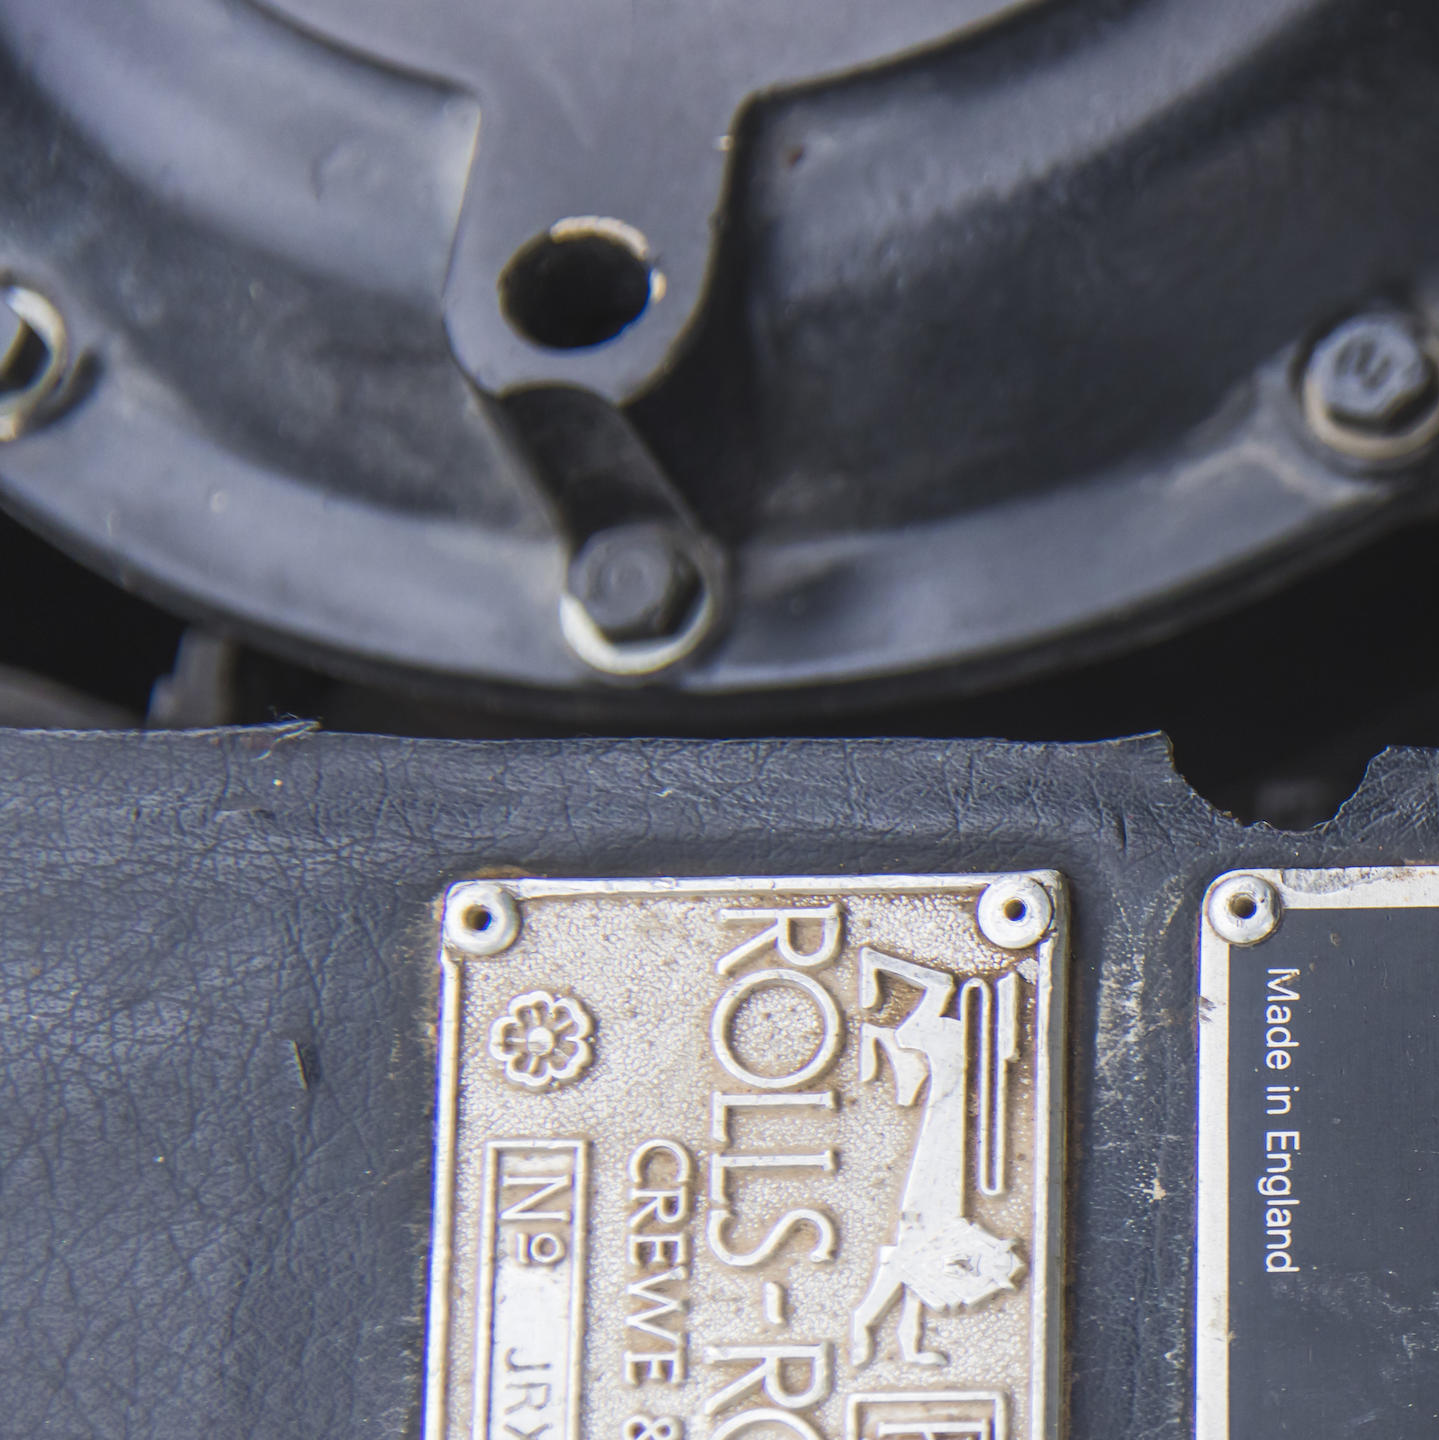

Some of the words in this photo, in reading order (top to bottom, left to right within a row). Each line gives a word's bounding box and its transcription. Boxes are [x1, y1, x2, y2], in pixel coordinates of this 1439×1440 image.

[1265, 967, 1301, 1070] Made
[1265, 1086, 1301, 1115] in
[625, 1140, 691, 1384] CREWE
[1257, 1129, 1301, 1274] England
